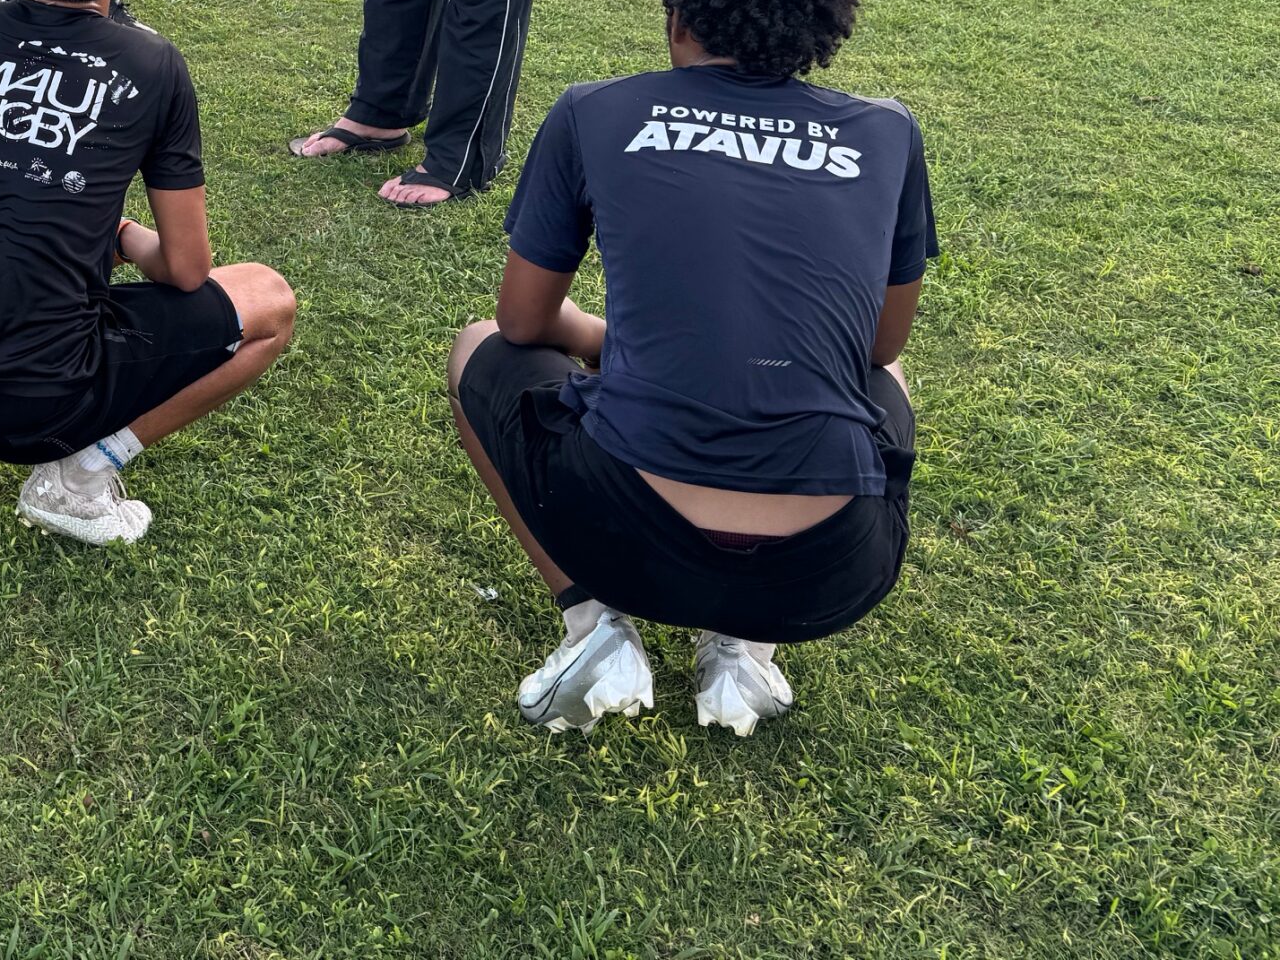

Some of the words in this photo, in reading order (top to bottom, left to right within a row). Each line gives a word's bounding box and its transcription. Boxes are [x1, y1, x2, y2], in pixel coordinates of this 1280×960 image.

[651, 105, 796, 133] POWERED
[807, 121, 840, 140] BY
[624, 120, 863, 179] ATAVUS
